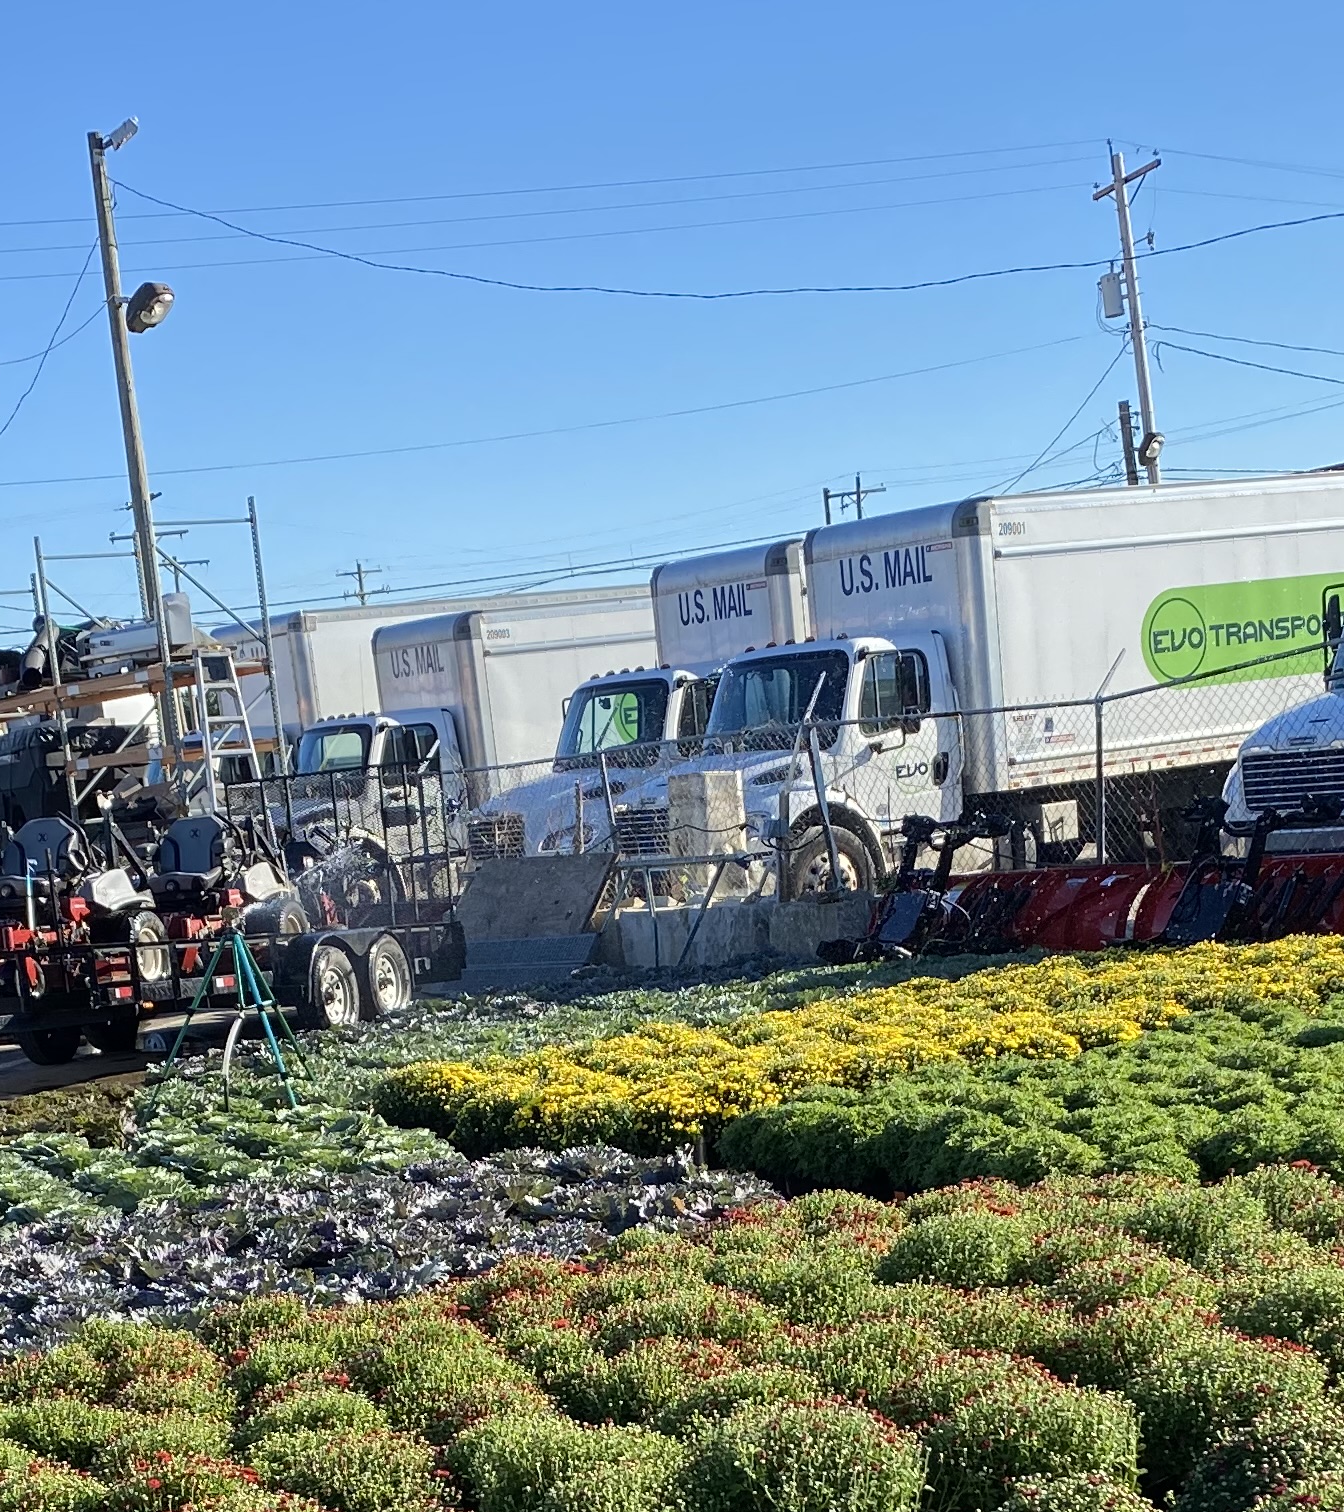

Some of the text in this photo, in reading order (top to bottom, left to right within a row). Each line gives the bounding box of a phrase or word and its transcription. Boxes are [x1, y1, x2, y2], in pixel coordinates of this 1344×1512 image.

[998, 521, 1026, 535] 209001
[839, 545, 933, 596] U.S. MAIL
[678, 583, 753, 626] U.S. MAIL
[390, 644, 445, 678] U.S. MAIL
